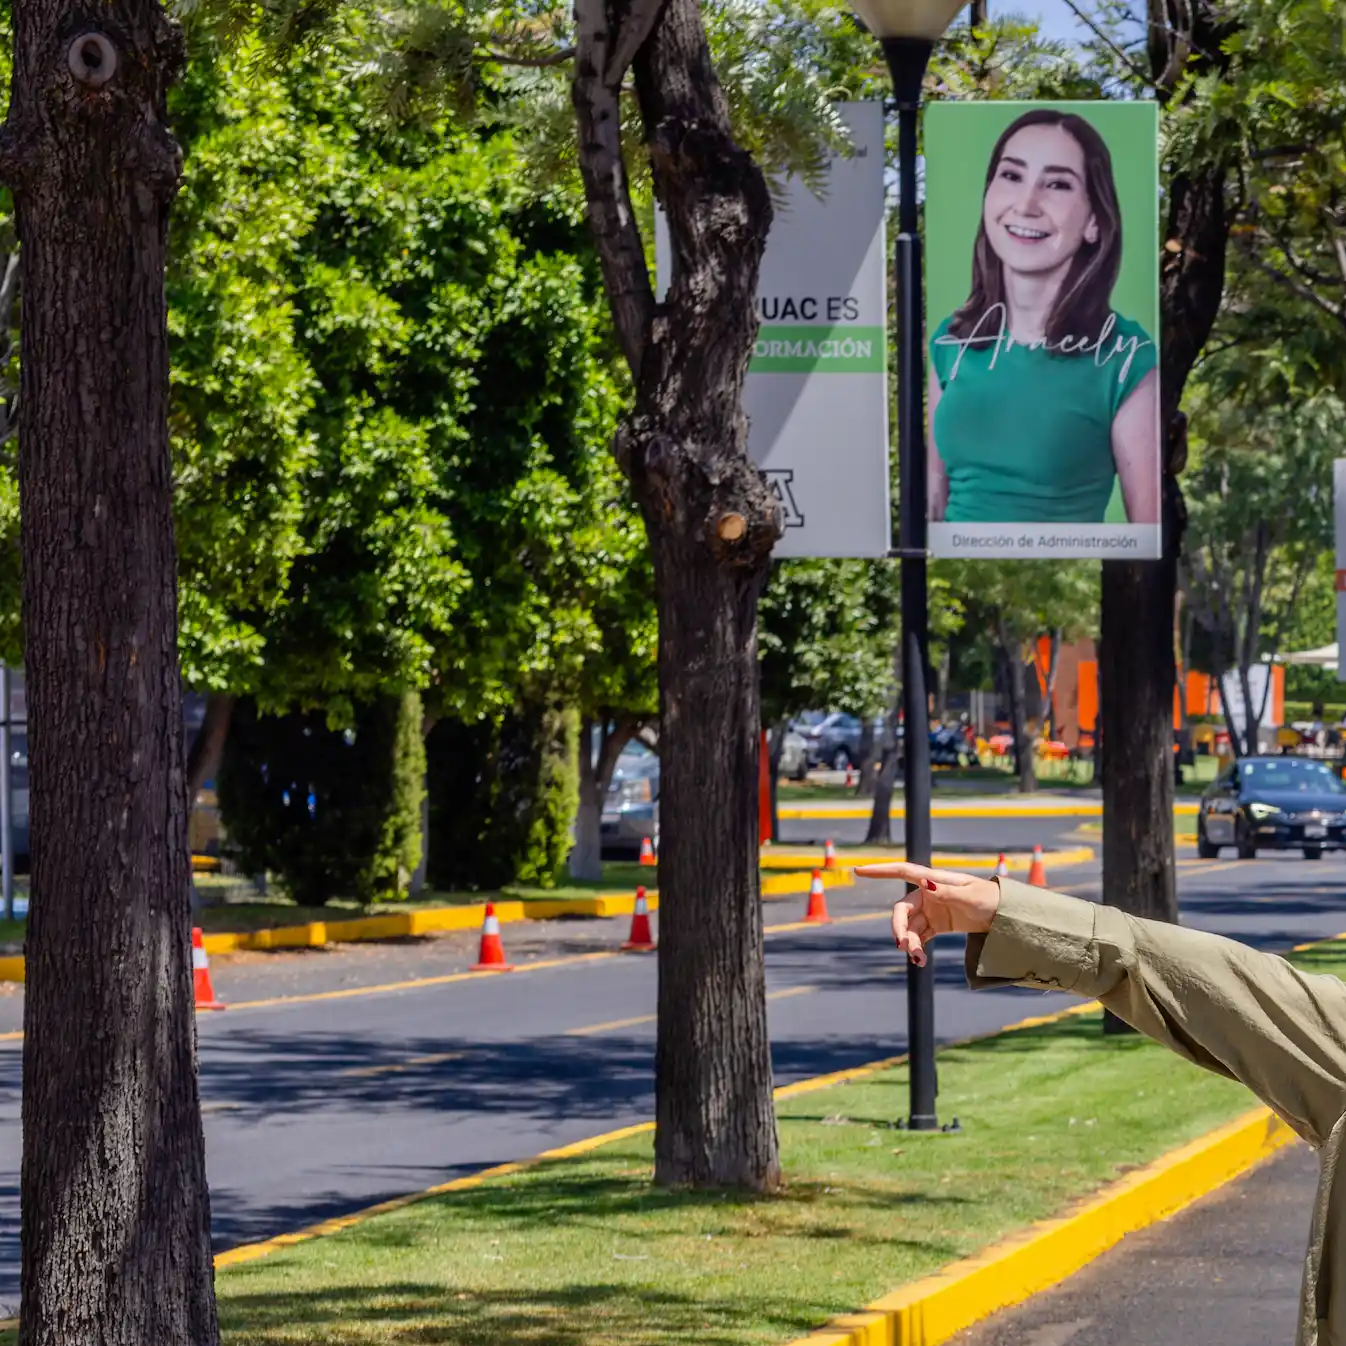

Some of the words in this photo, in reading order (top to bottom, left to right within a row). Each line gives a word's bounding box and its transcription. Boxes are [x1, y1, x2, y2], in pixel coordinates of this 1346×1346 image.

[759, 297, 817, 320] UAC
[826, 297, 859, 320] ES
[753, 337, 872, 358] ORMACIÓN
[935, 302, 1151, 383] Aracely
[952, 534, 1014, 548] Dirección
[1017, 535, 1034, 548] de
[1037, 535, 1138, 549] Administración
